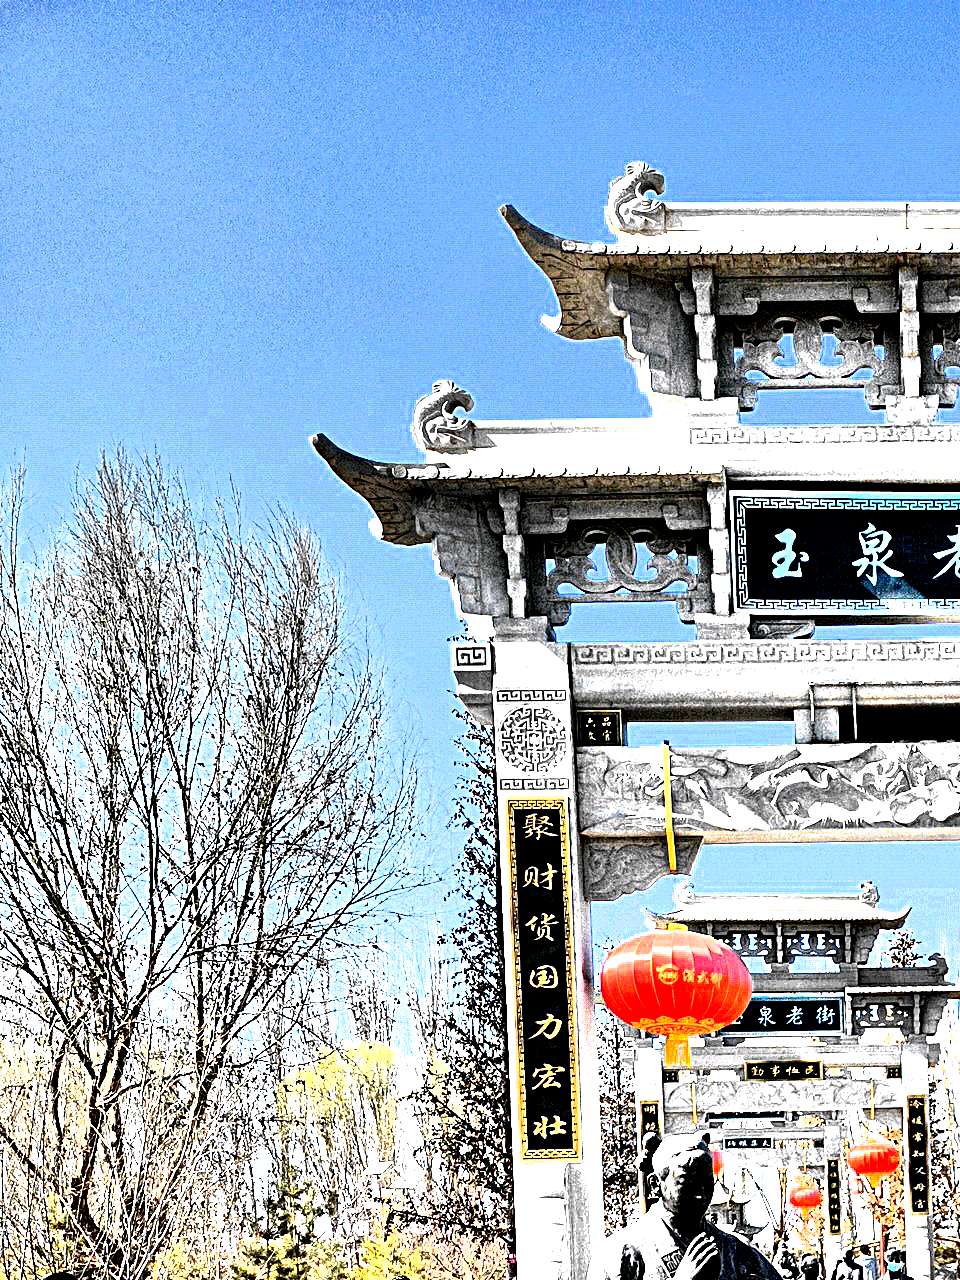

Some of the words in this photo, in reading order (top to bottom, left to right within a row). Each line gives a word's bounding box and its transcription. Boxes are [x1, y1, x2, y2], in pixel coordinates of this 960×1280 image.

[521, 812, 567, 1140] 聚财货国力宏壮
[731, 1005, 836, 1026] 泉老街
